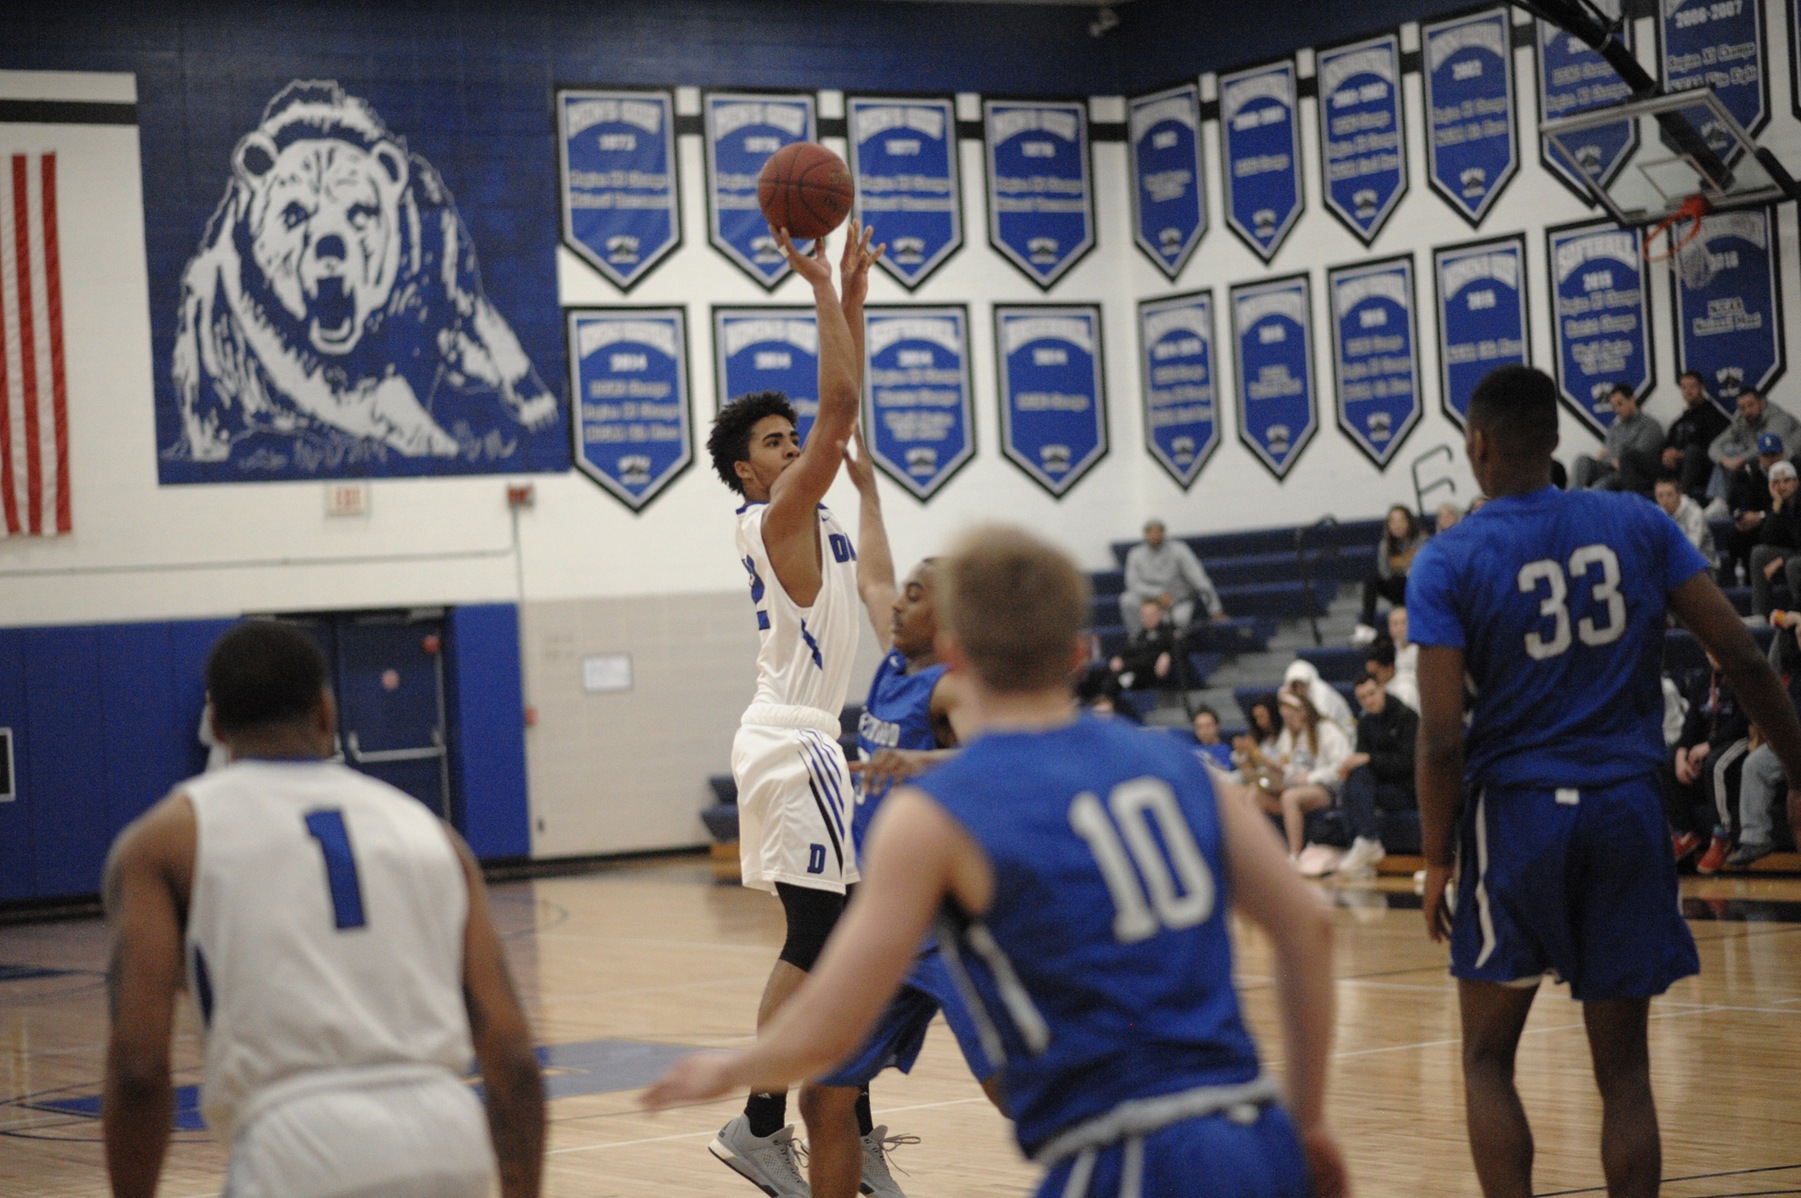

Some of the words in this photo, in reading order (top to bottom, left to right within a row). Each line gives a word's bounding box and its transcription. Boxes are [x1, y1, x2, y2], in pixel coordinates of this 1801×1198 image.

[1517, 544, 1626, 660] 33
[303, 807, 367, 930] 1
[807, 843, 826, 875] D
[1068, 776, 1215, 942] 10
